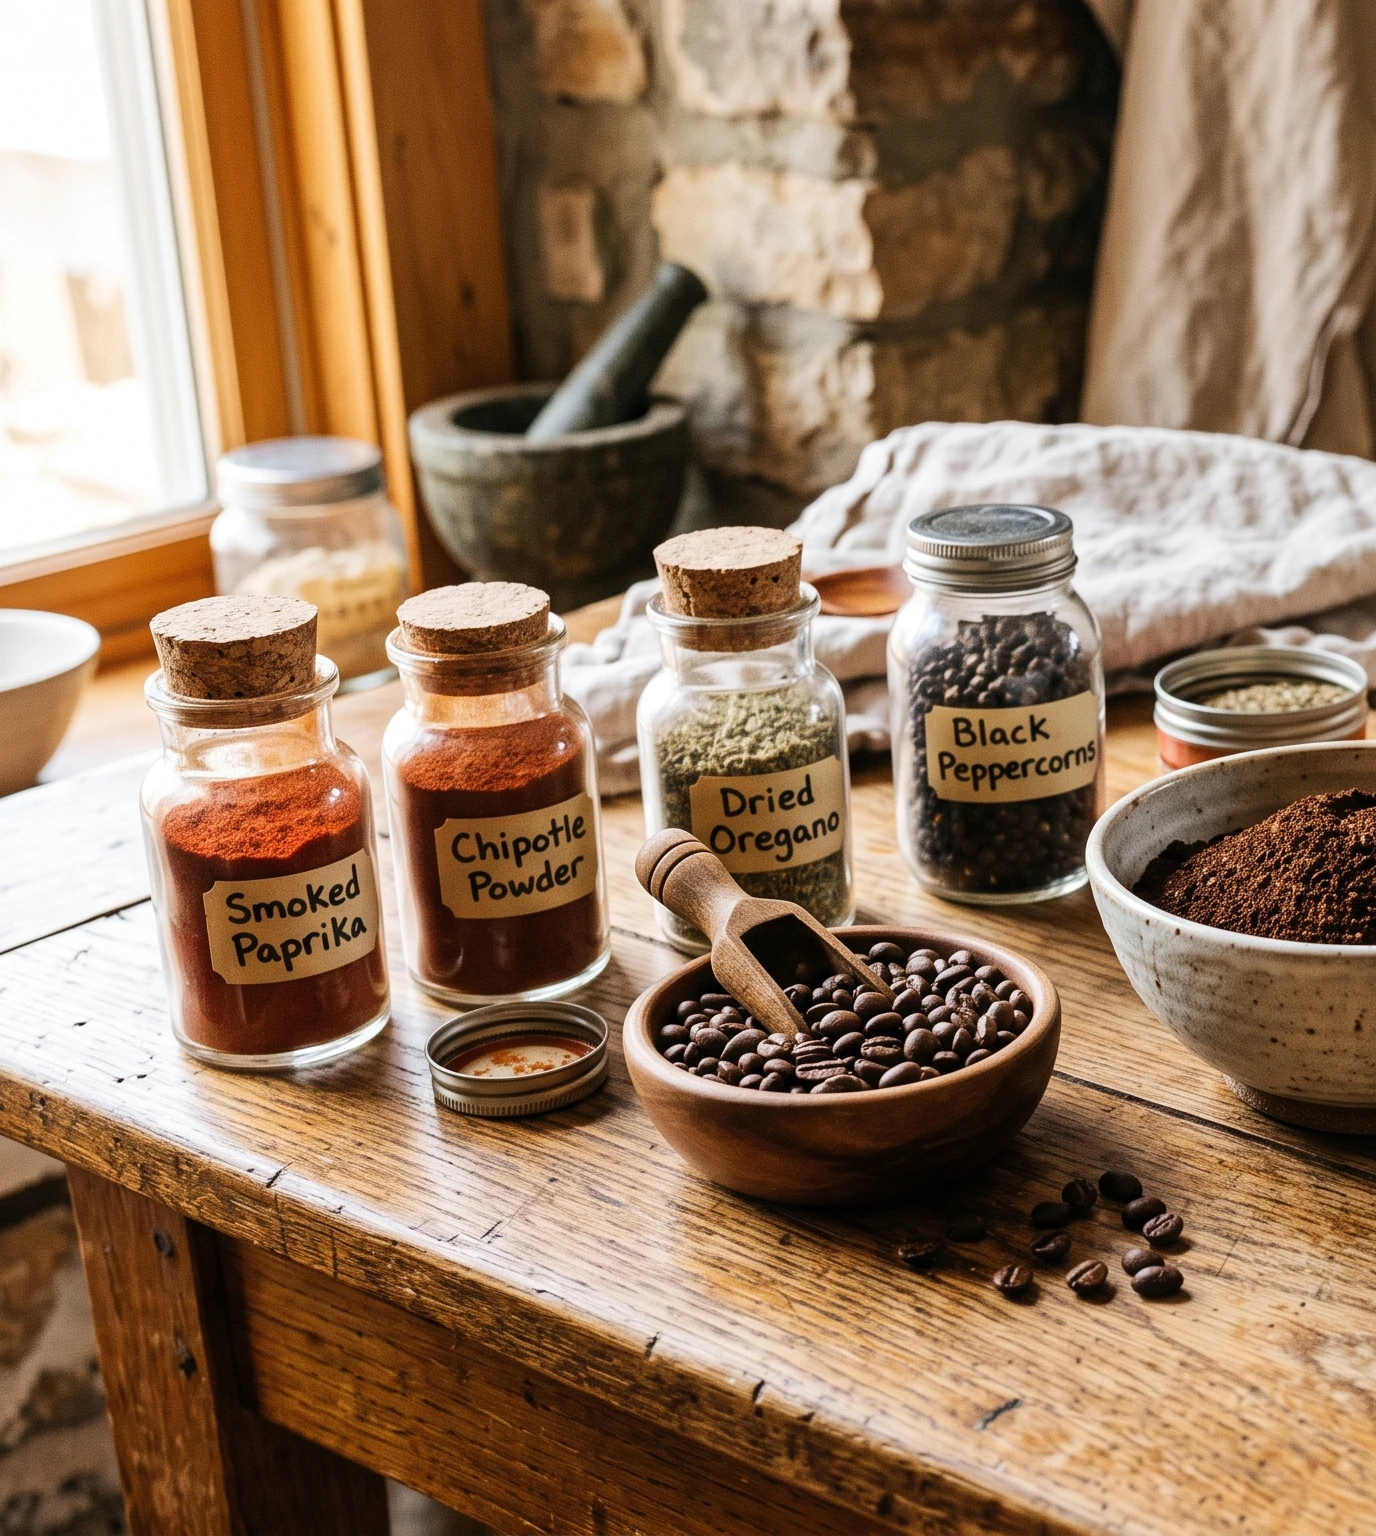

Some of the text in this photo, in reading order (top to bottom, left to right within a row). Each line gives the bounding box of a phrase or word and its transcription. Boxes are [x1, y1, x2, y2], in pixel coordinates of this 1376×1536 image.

[952, 714, 1050, 748] Black
[937, 740, 1096, 792] Peppercorns
[719, 773, 815, 817] Dried
[451, 814, 586, 868] Chipotle
[709, 811, 840, 862] Oregano
[225, 863, 361, 925] Smoked
[467, 855, 585, 902] Powder
[231, 916, 367, 972] Paprika
